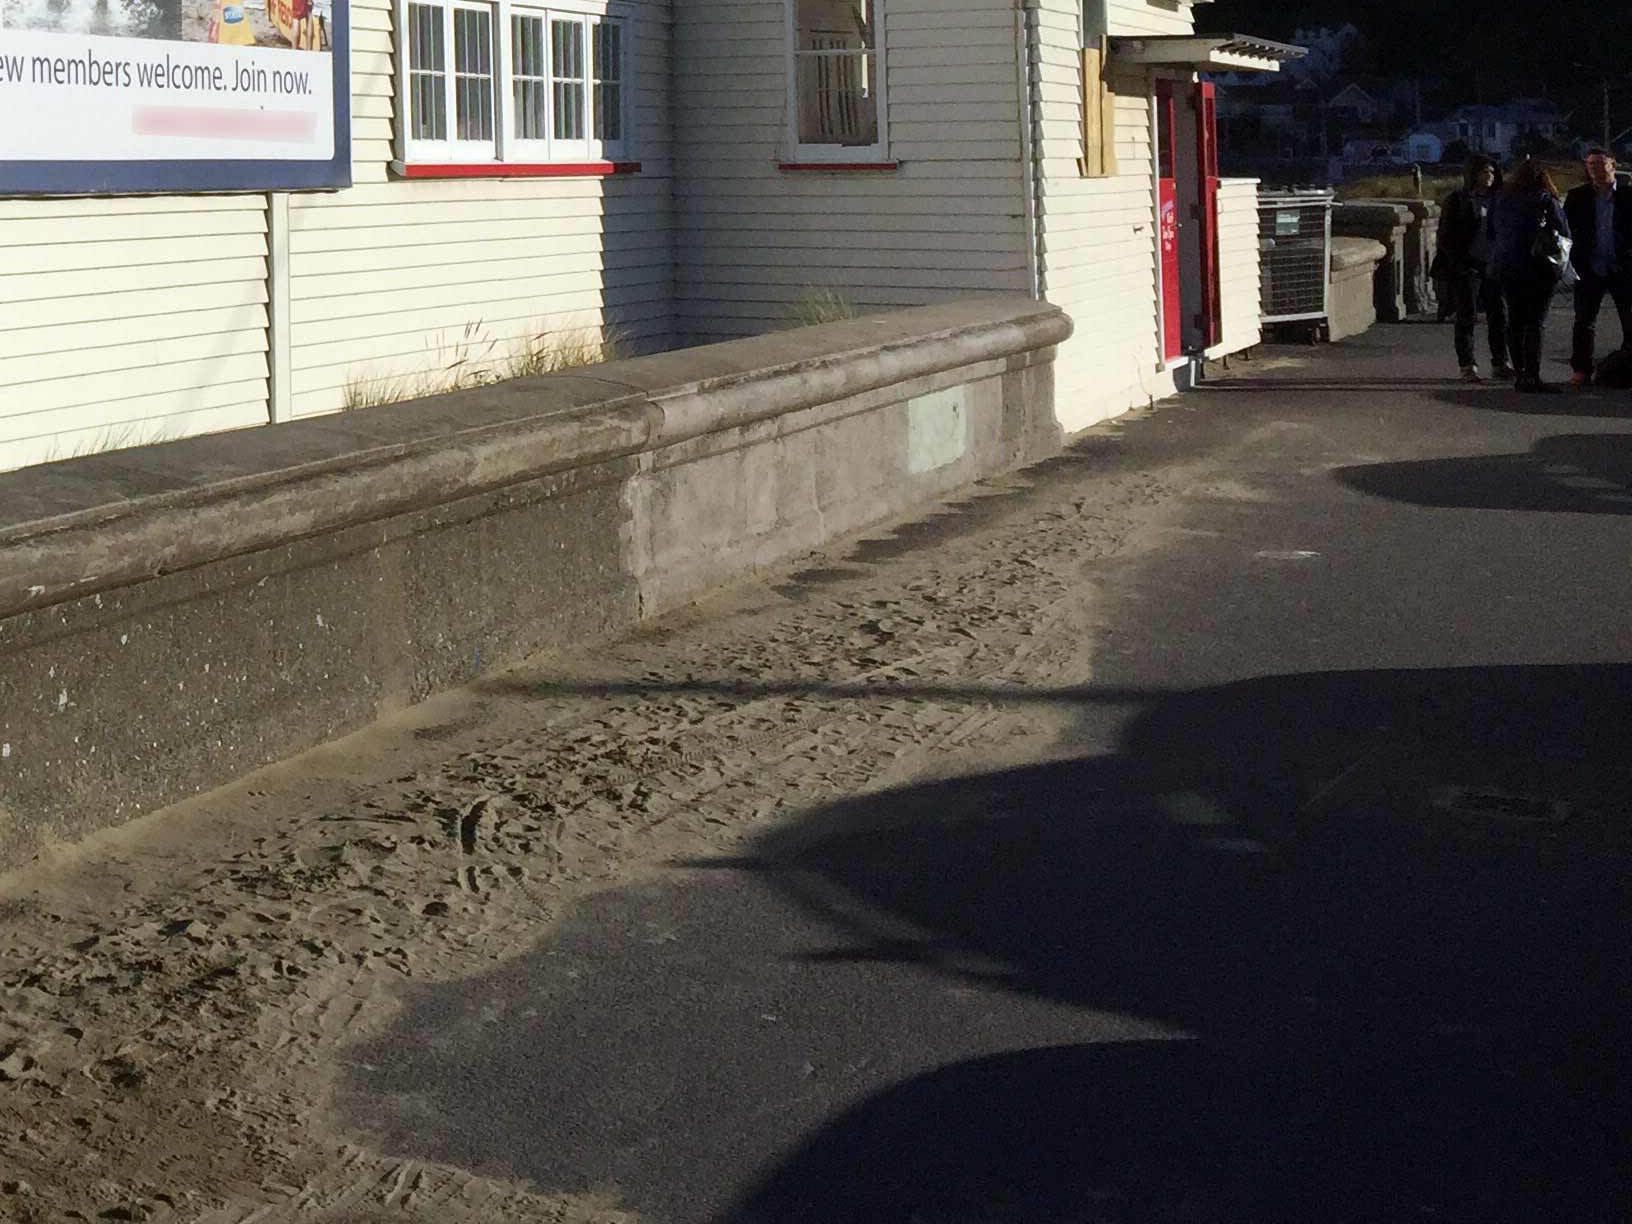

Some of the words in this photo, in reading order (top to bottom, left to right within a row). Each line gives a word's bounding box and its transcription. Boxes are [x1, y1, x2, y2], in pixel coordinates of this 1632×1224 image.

[31, 49, 131, 88] members
[137, 54, 227, 91] welcome.
[232, 60, 268, 93] Join
[272, 70, 313, 95] now.
